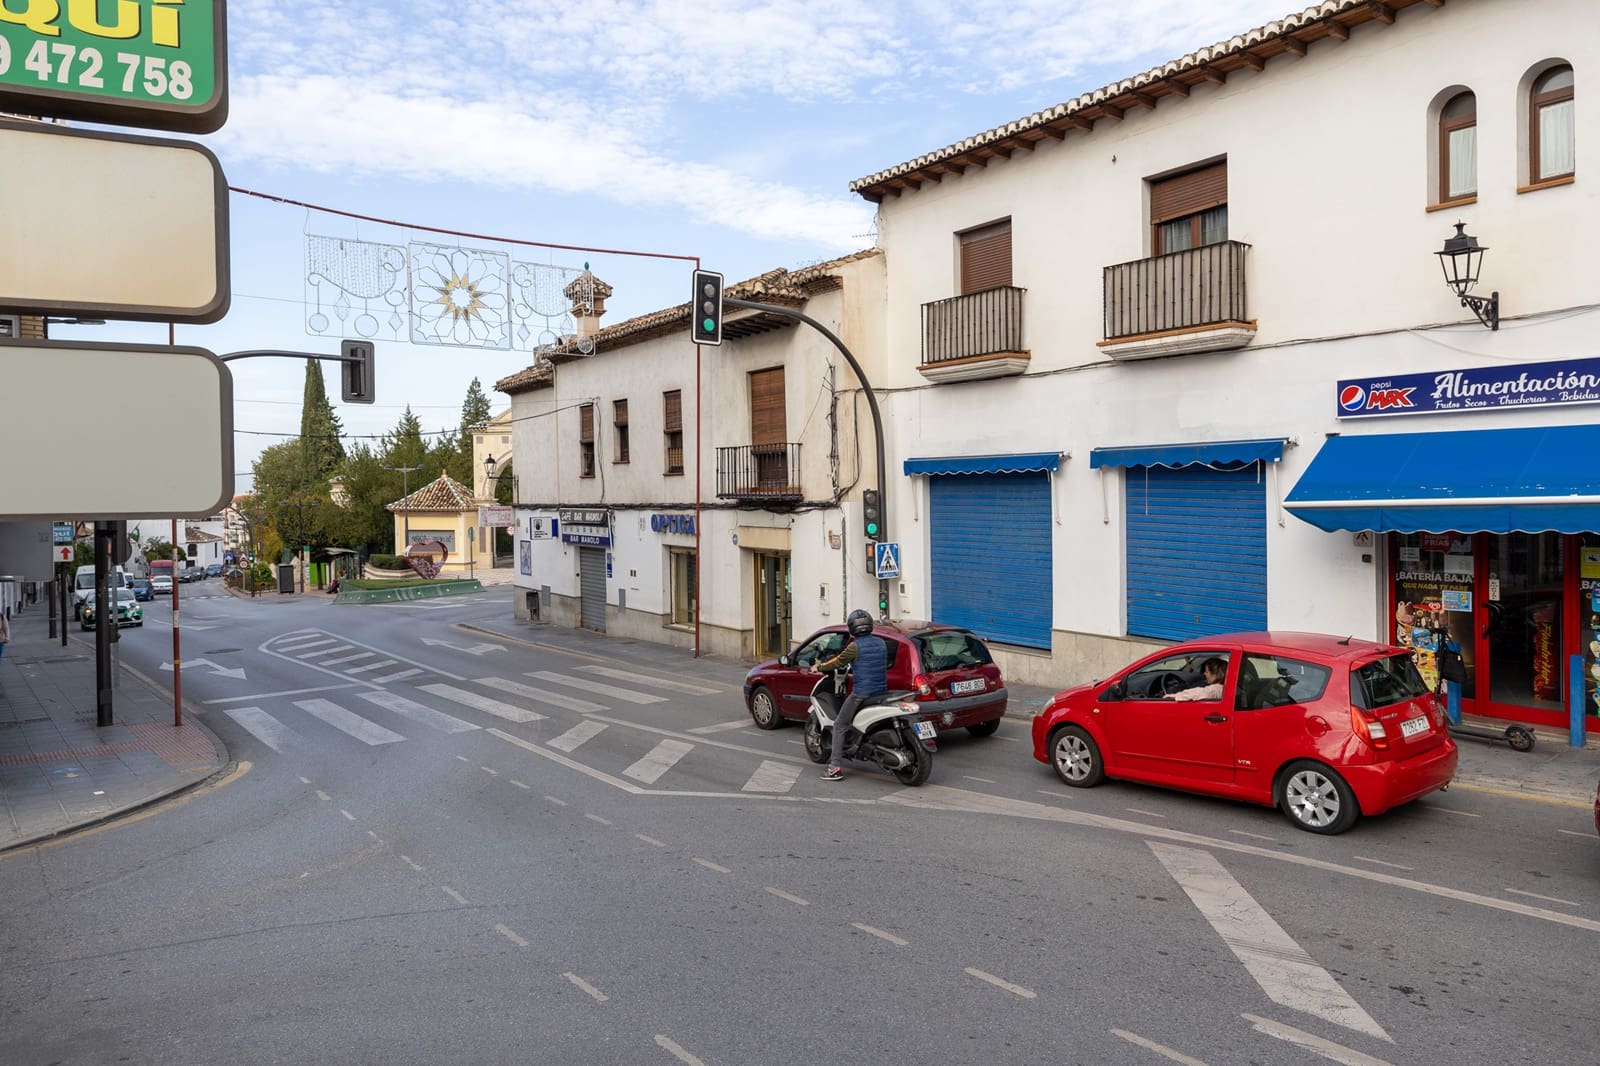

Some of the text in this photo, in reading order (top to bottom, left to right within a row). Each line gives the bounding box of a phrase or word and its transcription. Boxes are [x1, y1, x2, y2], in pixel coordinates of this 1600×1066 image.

[25, 39, 104, 88] 472
[117, 52, 193, 99] 758
[1370, 381, 1392, 389] pepsi
[1430, 371, 1600, 398] Alimentación
[1366, 387, 1417, 409] MAX
[1464, 398, 1487, 408] Secos
[1558, 389, 1599, 401] Bebidas
[570, 535, 600, 545] BAR MANOLO
